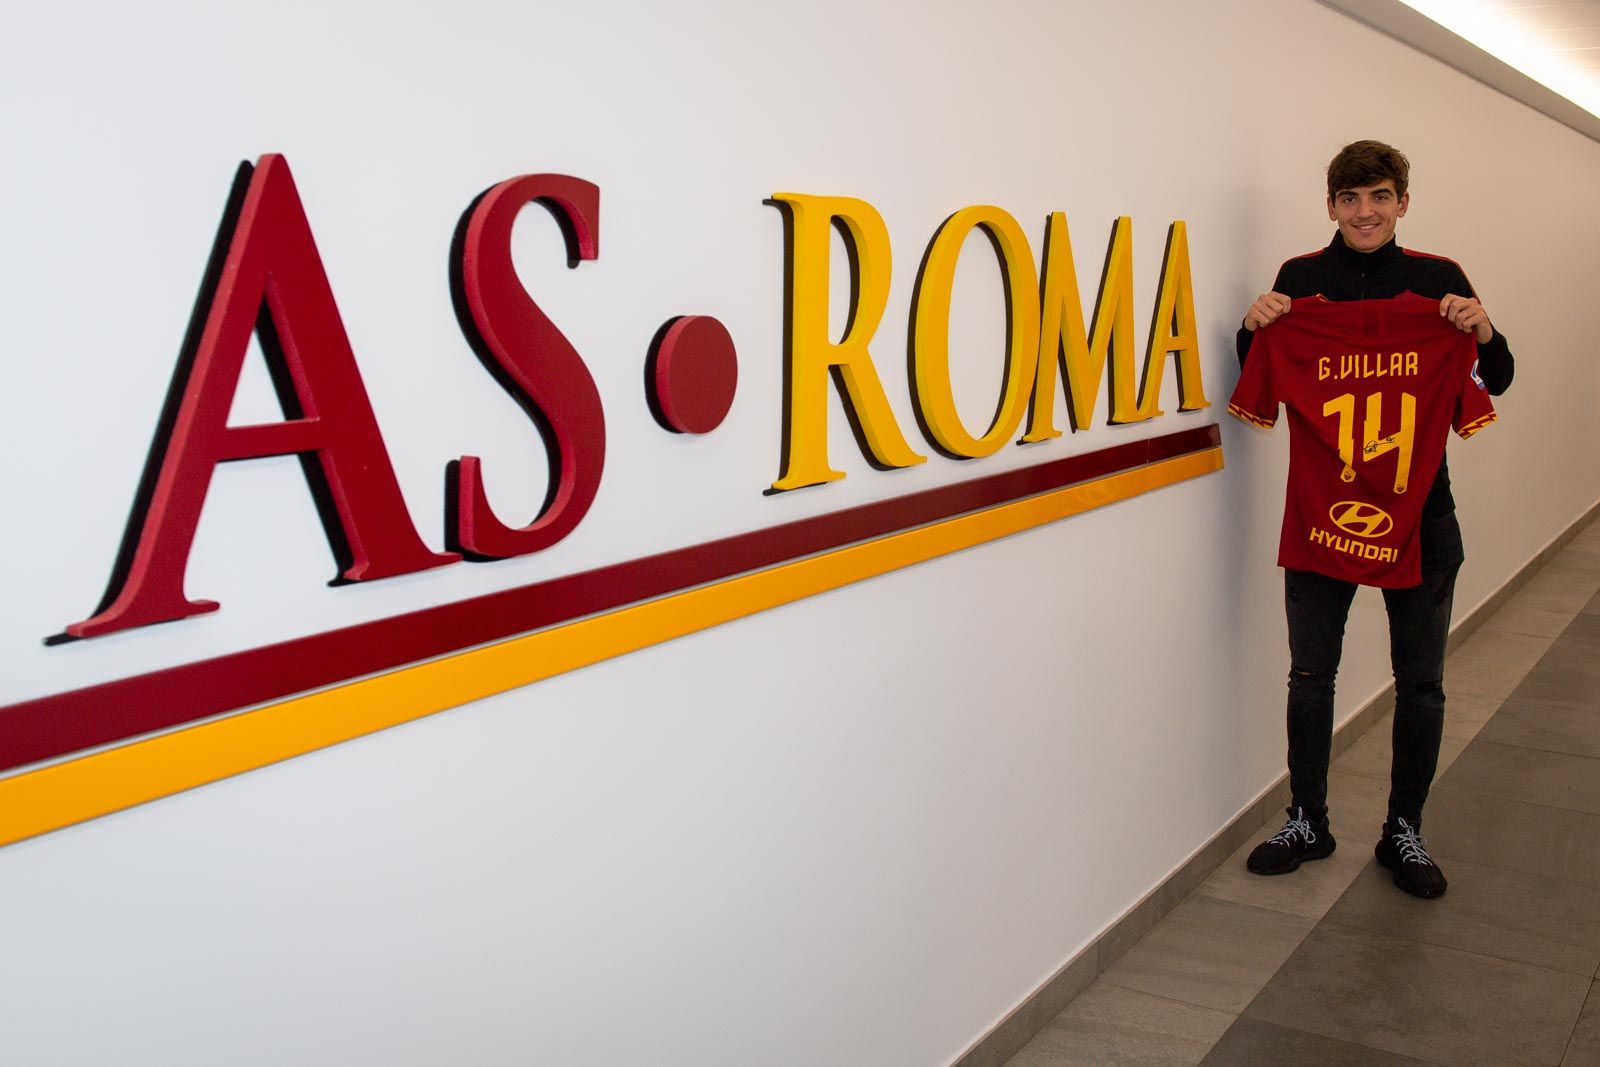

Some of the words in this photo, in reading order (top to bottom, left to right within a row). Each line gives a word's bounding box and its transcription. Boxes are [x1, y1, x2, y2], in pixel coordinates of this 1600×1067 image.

[60, 152, 606, 640] AS
[766, 192, 1211, 494] ROMA
[1318, 351, 1418, 381] G.VILLAR
[1322, 391, 1417, 494] 14
[1309, 527, 1398, 563] HYUNDAI
